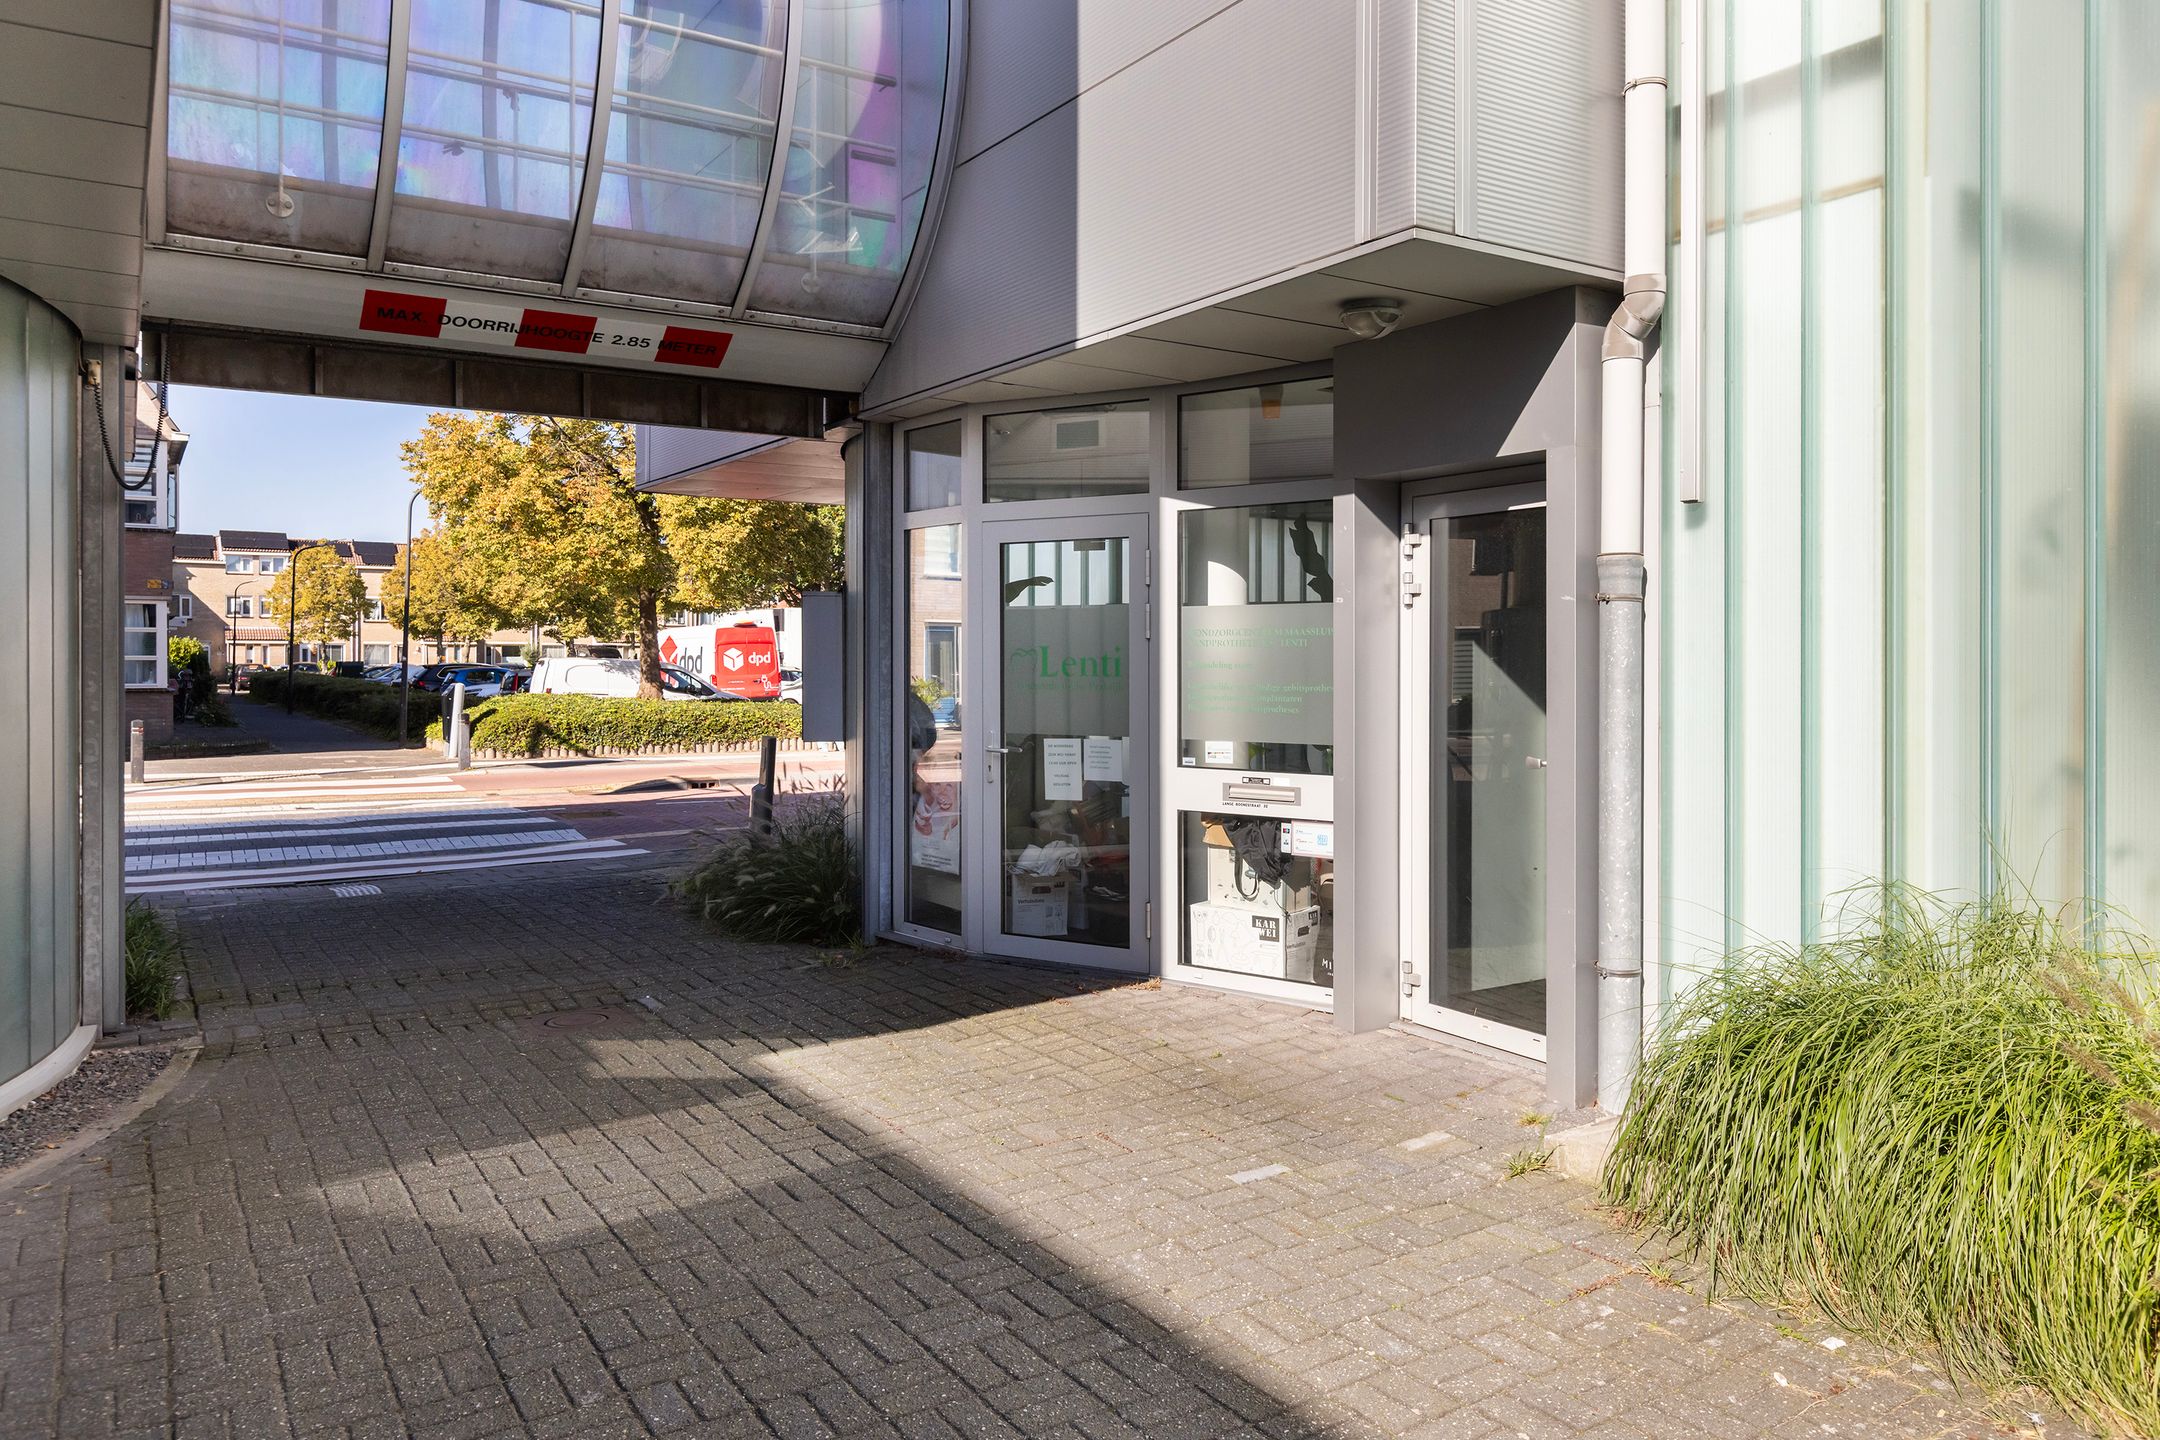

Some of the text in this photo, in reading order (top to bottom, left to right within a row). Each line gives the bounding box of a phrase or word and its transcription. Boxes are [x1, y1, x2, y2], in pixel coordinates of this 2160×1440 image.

[376, 307, 427, 325] MAX.
[610, 333, 651, 350] 2.85
[657, 339, 718, 357] METER
[679, 646, 703, 674] dpd
[748, 650, 771, 667] dpd
[1039, 644, 1122, 678] Lenti
[1255, 919, 1277, 929] KAR
[1258, 928, 1277, 938] WEI
